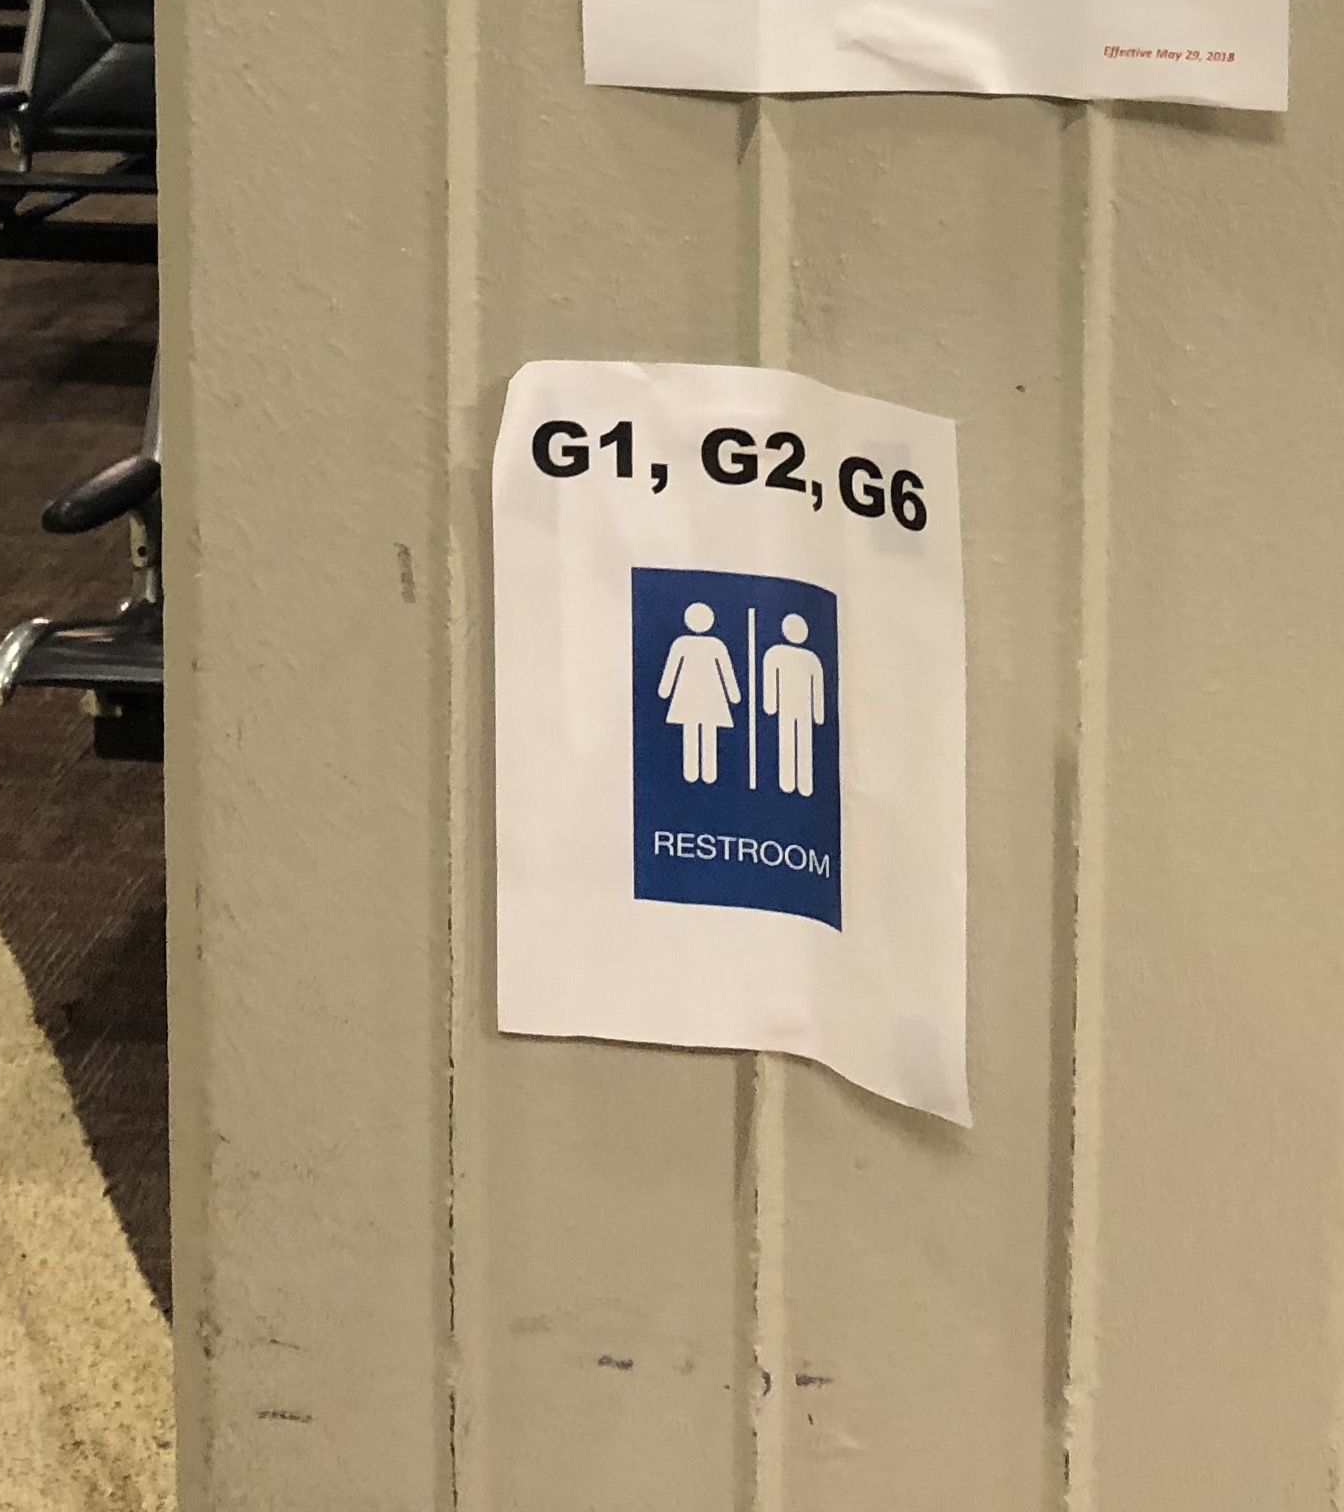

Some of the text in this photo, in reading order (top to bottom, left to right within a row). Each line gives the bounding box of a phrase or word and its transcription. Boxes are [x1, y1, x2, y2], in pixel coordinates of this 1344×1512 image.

[1103, 45, 1153, 59] Effective
[1156, 48, 1183, 62] May
[1206, 51, 1236, 63] 2018
[532, 420, 928, 532] G1, G2, G6
[654, 830, 830, 879] RESTROOM
